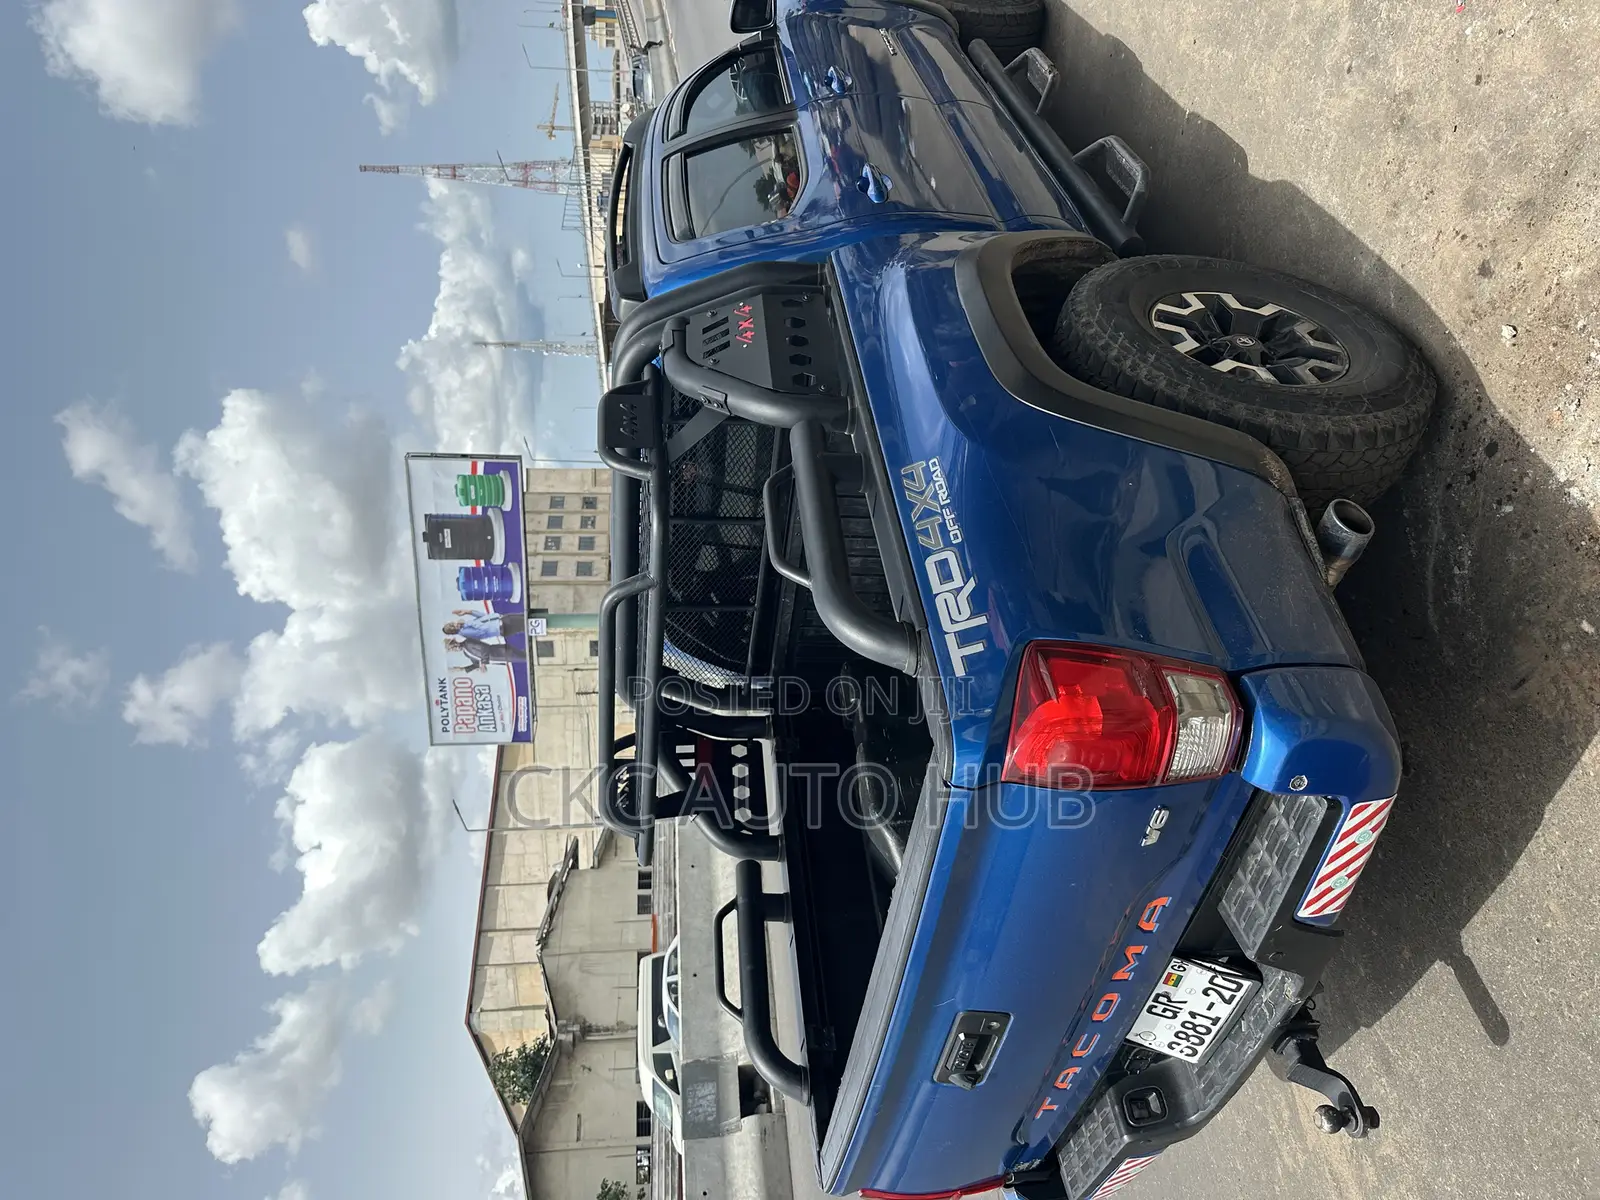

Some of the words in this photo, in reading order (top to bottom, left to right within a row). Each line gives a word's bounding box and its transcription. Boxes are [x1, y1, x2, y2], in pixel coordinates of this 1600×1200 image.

[900, 460, 944, 550] 4X4
[928, 456, 952, 505] ROAD
[942, 505, 963, 544] OFF
[530, 620, 540, 634] PG
[925, 547, 988, 677] TRD
[437, 677, 450, 733] POLYTANK
[452, 677, 476, 734] Papano
[474, 684, 497, 732] Ankasa
[1139, 805, 1171, 847] V6
[1033, 896, 1173, 1120] TACOMA
[1145, 992, 1188, 1020] GR
